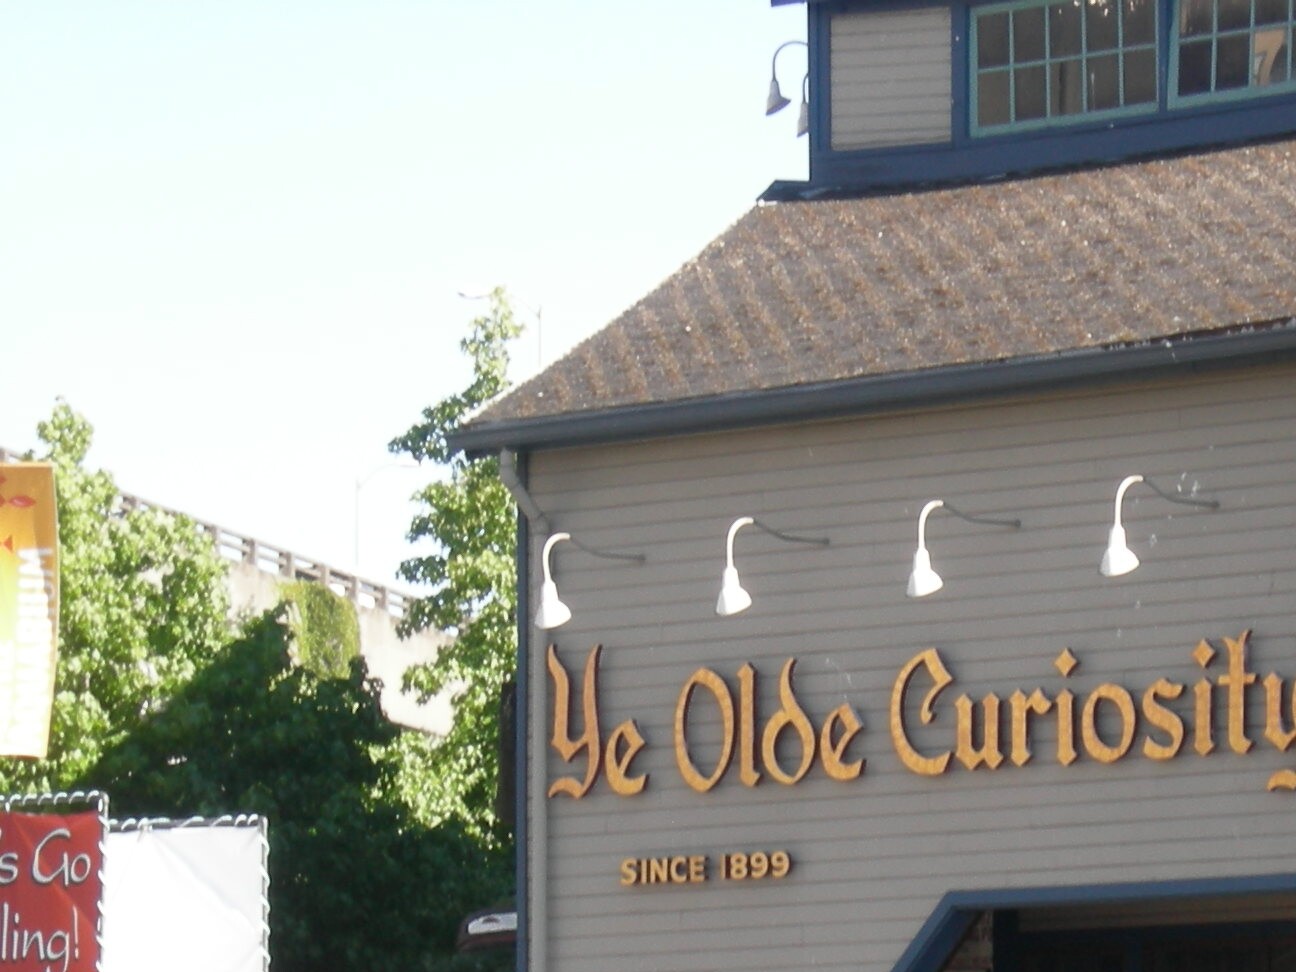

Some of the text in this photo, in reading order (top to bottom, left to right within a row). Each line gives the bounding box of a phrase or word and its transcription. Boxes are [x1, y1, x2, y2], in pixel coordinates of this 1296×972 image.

[547, 643, 649, 799] Ye
[674, 657, 866, 792] Olde
[32, 828, 92, 888] Go
[620, 850, 793, 886] SINCE 1899
